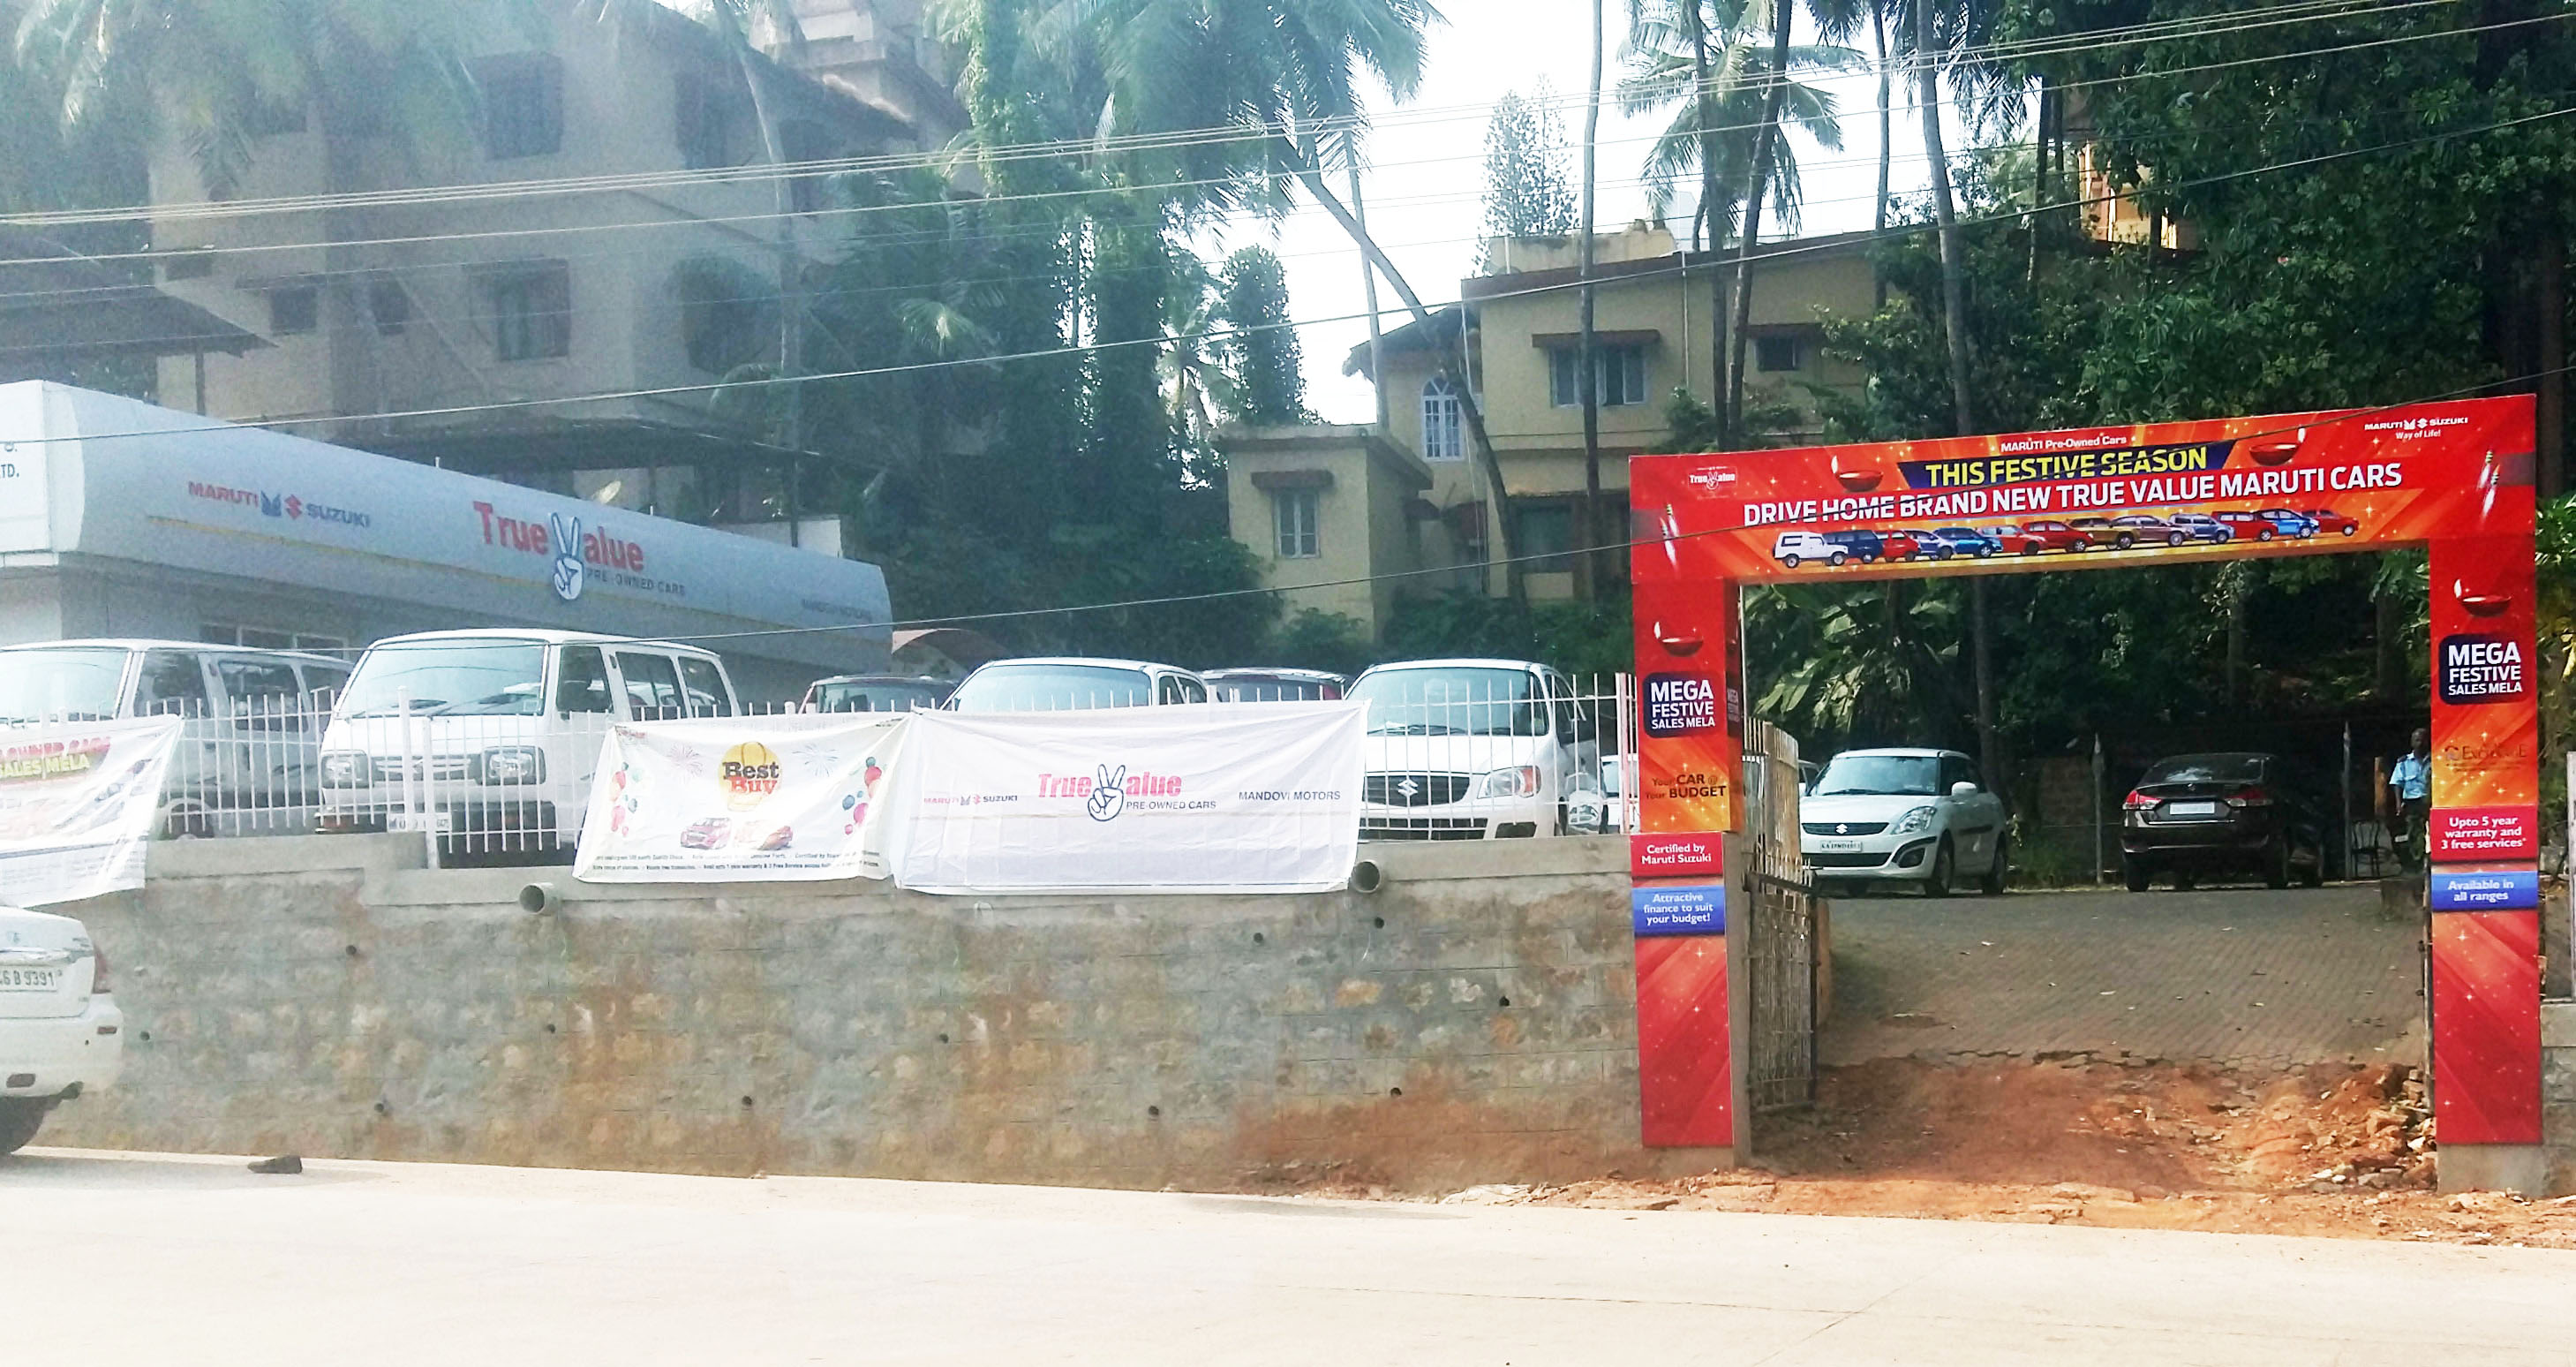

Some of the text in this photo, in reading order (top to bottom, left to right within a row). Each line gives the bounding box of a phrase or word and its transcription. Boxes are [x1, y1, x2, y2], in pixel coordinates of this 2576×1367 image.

[2364, 417, 2468, 431] MARUTI SUZUKI
[2395, 431, 2414, 441] Way
[2423, 429, 2441, 438] Life!
[2000, 435, 2127, 452] MARUTI Pre-Owned Cars
[1925, 446, 2207, 487] THIS FESTIVE SEASON
[1744, 463, 2403, 527] DRIVE HOME BRAND NEW TRUE VALUE MARUTI CARS
[188, 480, 372, 529] MARUTI SUZUKI
[473, 501, 549, 555] True
[2448, 641, 2522, 667] MEGA
[2449, 665, 2522, 684] FESTIVE
[1651, 679, 1714, 703] MEGA
[2448, 681, 2523, 696] SALES MELA
[1652, 701, 1714, 718] FESTIVE
[1652, 716, 1716, 730] SALES MELA
[44, 752, 91, 774] MELA
[722, 760, 780, 779] Best
[729, 775, 778, 794] Buy
[1038, 773, 1093, 798] True
[1676, 774, 1706, 785] CAR
[1238, 790, 1342, 801] MANDOVI MOTORS
[1668, 785, 1727, 798] BUDGET
[1126, 800, 1217, 810] PRE-OWNED CARS
[2449, 816, 2519, 829] Upto 5 year
[2444, 827, 2522, 840] warranty and
[1646, 842, 1706, 854] Certified by
[2441, 839, 2448, 850] 3
[2451, 839, 2474, 850] free
[1641, 853, 1712, 865] Maruti Suzuki
[2448, 880, 2515, 890] Available in
[1652, 892, 1704, 903] Attractive
[2453, 892, 2509, 903] all ranges
[1644, 903, 1714, 914] finance to suit
[1646, 912, 1711, 926] your budget!
